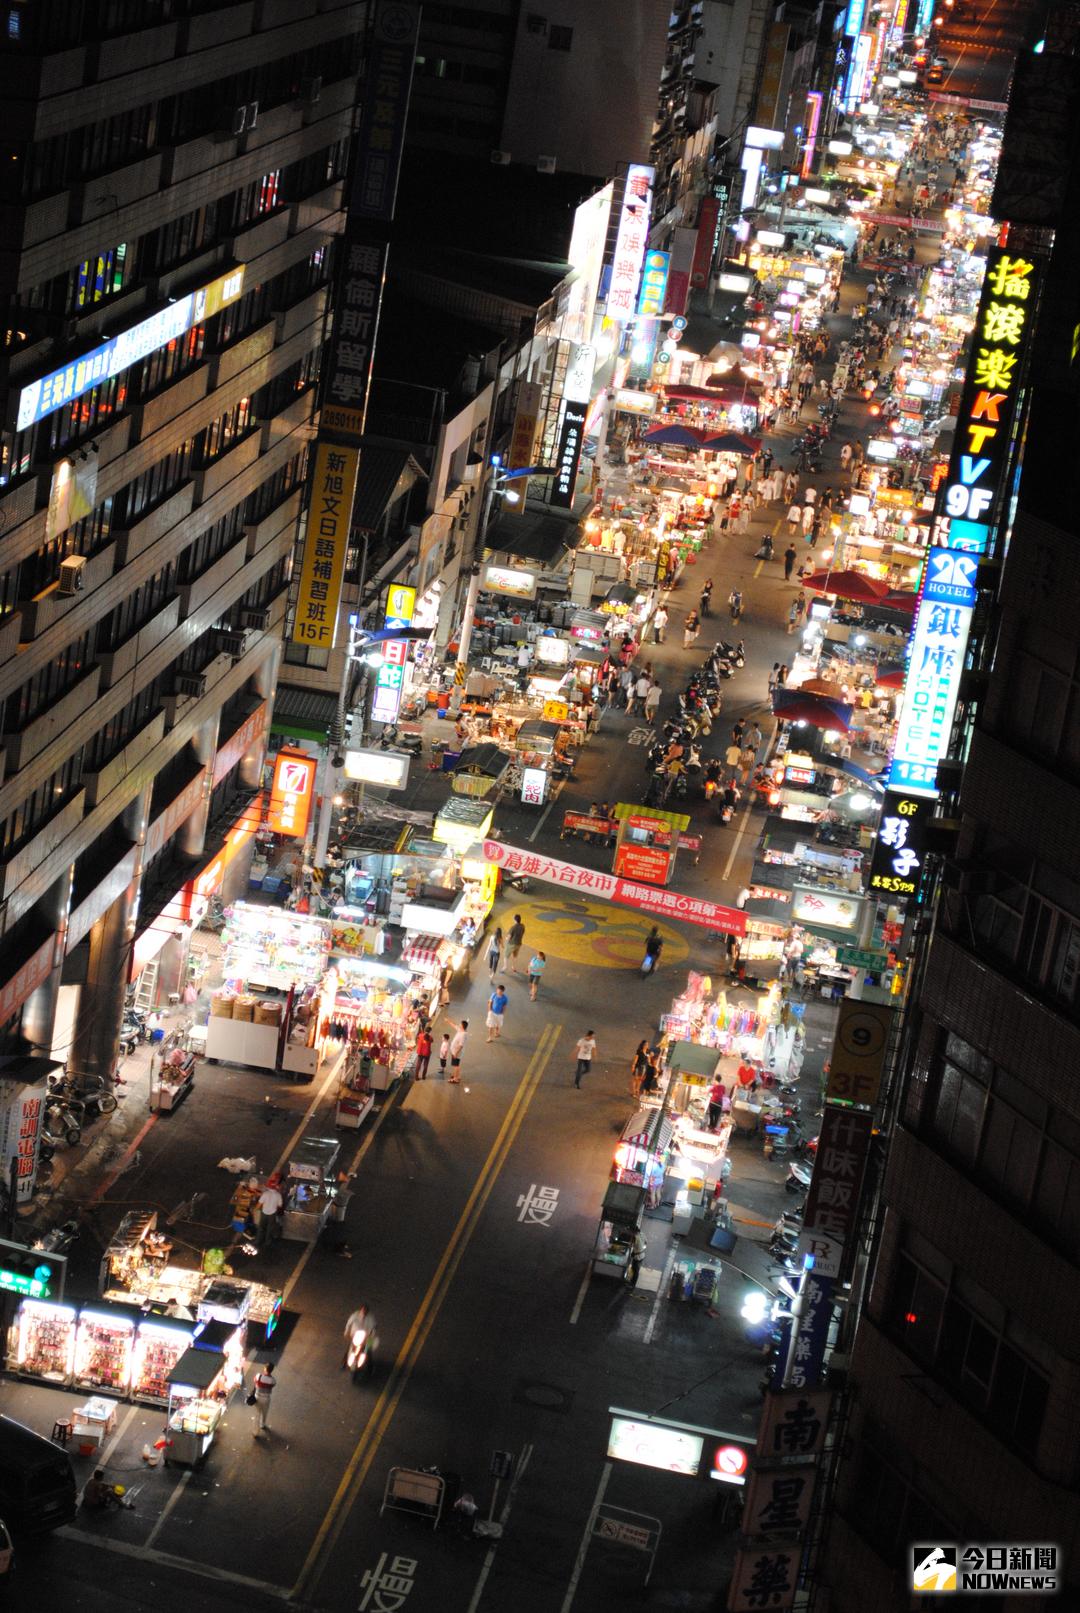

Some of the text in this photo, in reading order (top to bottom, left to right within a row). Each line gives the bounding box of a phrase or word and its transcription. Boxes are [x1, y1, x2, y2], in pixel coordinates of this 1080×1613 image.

[331, 244, 382, 402] 羅倫斯留學
[961, 390, 1009, 485] KTV
[946, 484, 993, 519] 9F
[307, 452, 348, 622] 新旭文日語補習班
[928, 582, 972, 599] HOTEL
[299, 621, 330, 641] 15F
[919, 604, 963, 677] 銀座
[898, 800, 918, 816] 6F
[504, 851, 613, 892] 高雄六合夜市
[832, 1072, 874, 1095] 3F
[516, 1183, 560, 1227] 慢
[358, 1552, 419, 1613] 慢
